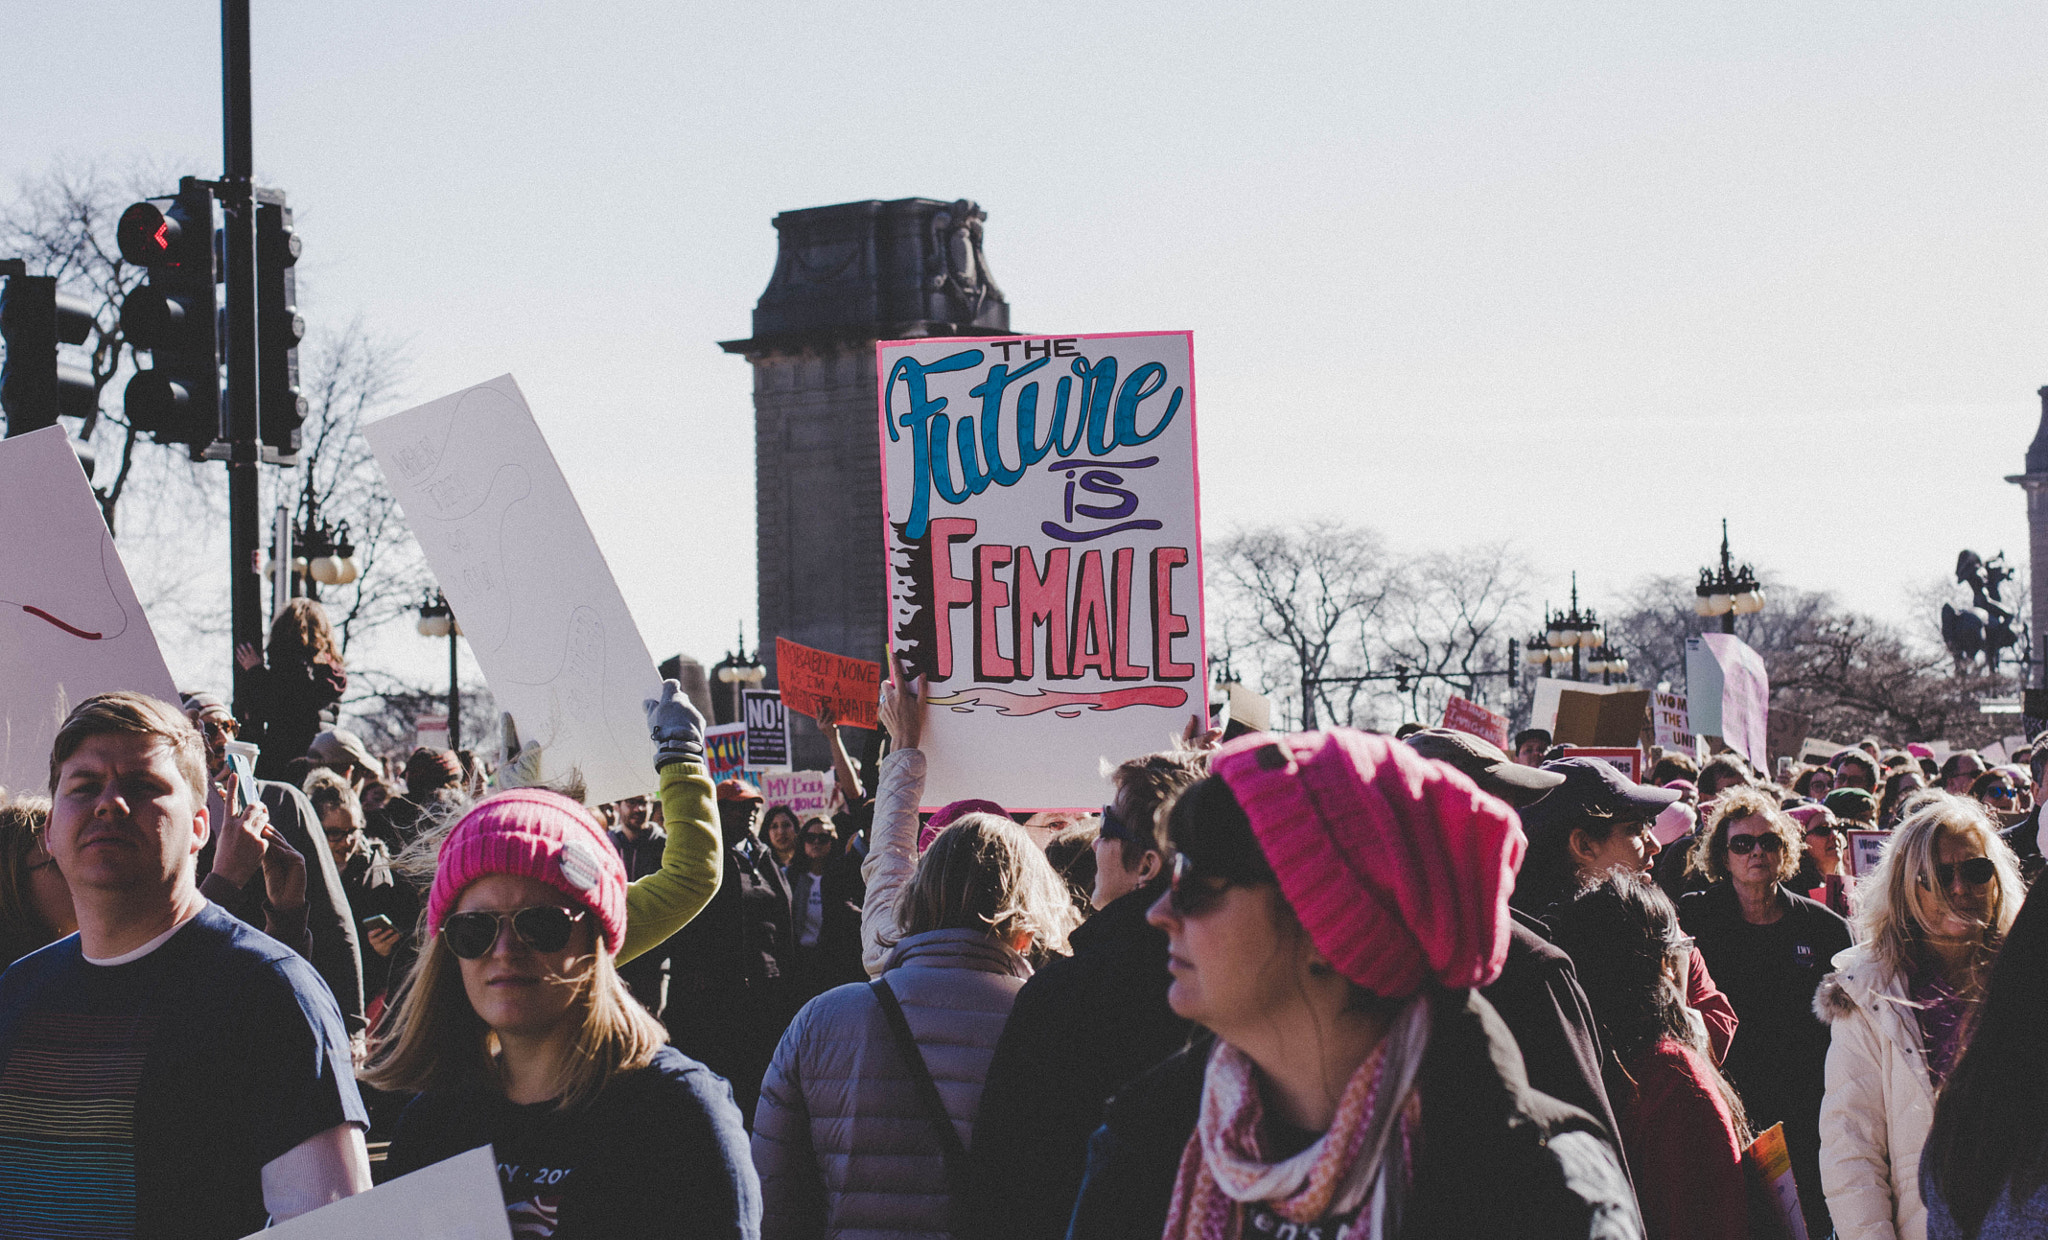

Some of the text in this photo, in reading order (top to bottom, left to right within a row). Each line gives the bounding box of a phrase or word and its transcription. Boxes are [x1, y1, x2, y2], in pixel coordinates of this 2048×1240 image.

[991, 338, 1081, 358] THE
[885, 349, 1183, 539] Future
[930, 518, 1195, 683] FEMALE
[837, 658, 878, 684] NONE
[747, 698, 783, 730] NO!
[1663, 711, 1682, 728] THE
[767, 777, 790, 798] MY
